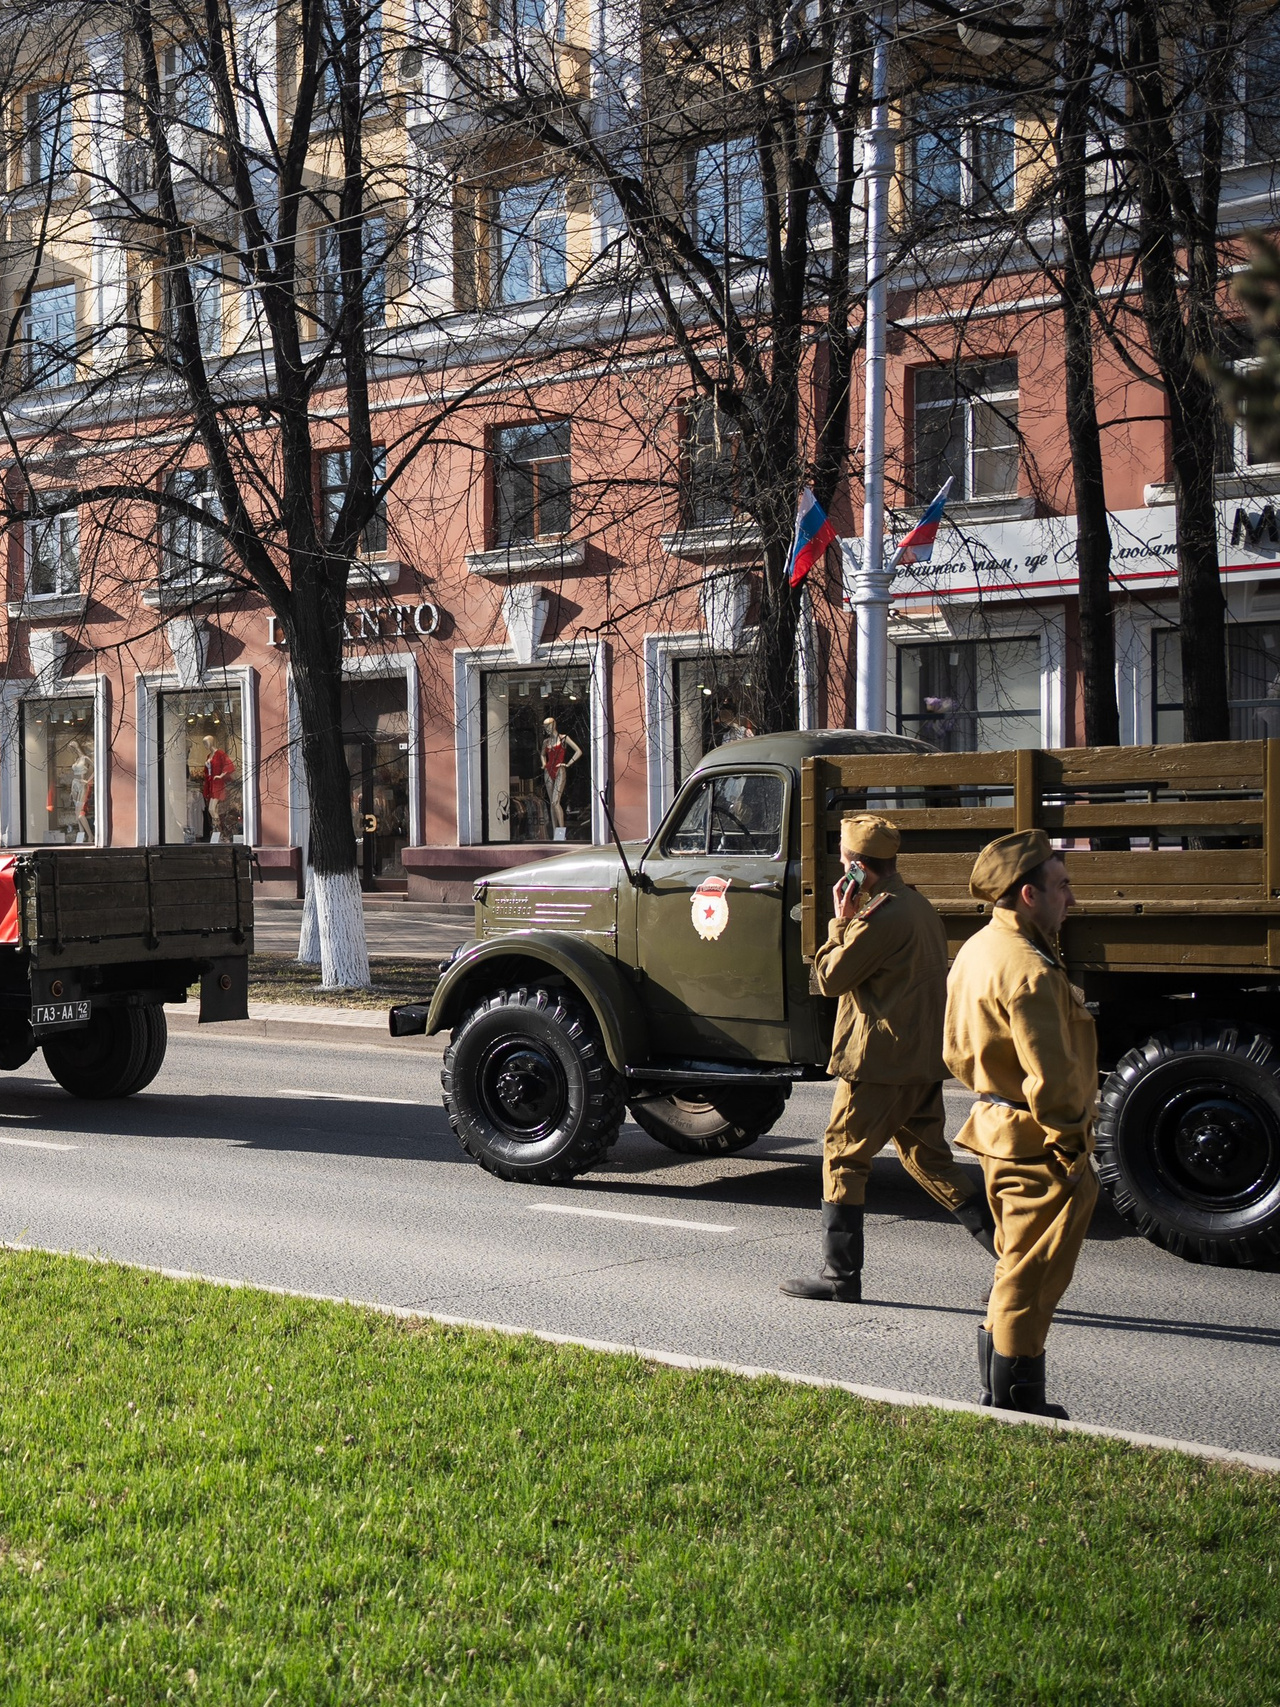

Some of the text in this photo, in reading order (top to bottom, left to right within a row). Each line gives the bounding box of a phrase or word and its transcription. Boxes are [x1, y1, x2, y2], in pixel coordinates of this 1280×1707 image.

[896, 561, 967, 578] евайтесь
[1025, 554, 1048, 573] где
[1111, 534, 1179, 560] любят
[266, 602, 439, 646] INTO
[36, 1004, 74, 1023] ГАЗ-АА
[77, 1002, 88, 1014] 42
